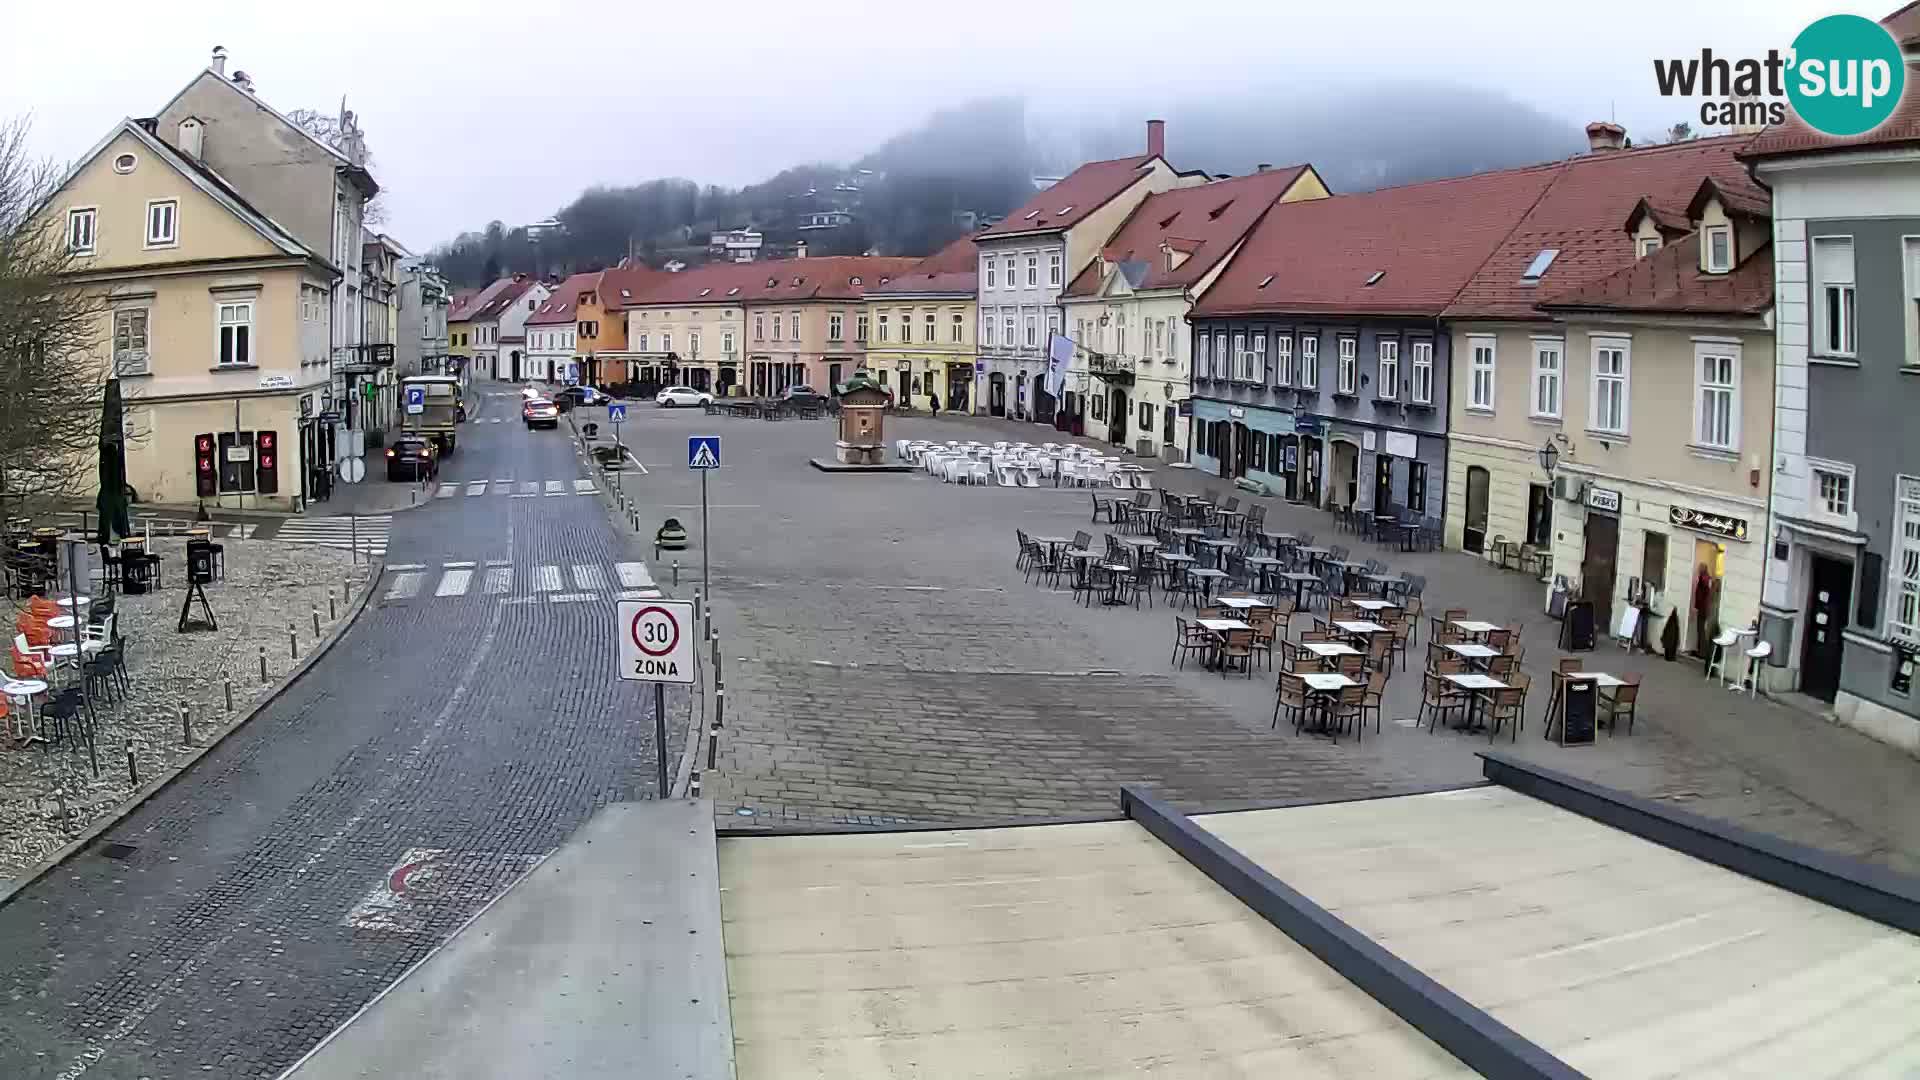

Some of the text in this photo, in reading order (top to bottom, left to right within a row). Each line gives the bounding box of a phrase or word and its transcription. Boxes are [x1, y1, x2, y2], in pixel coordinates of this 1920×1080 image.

[411, 391, 420, 404] P
[644, 622, 668, 643] 30
[635, 659, 679, 676] ZONA
